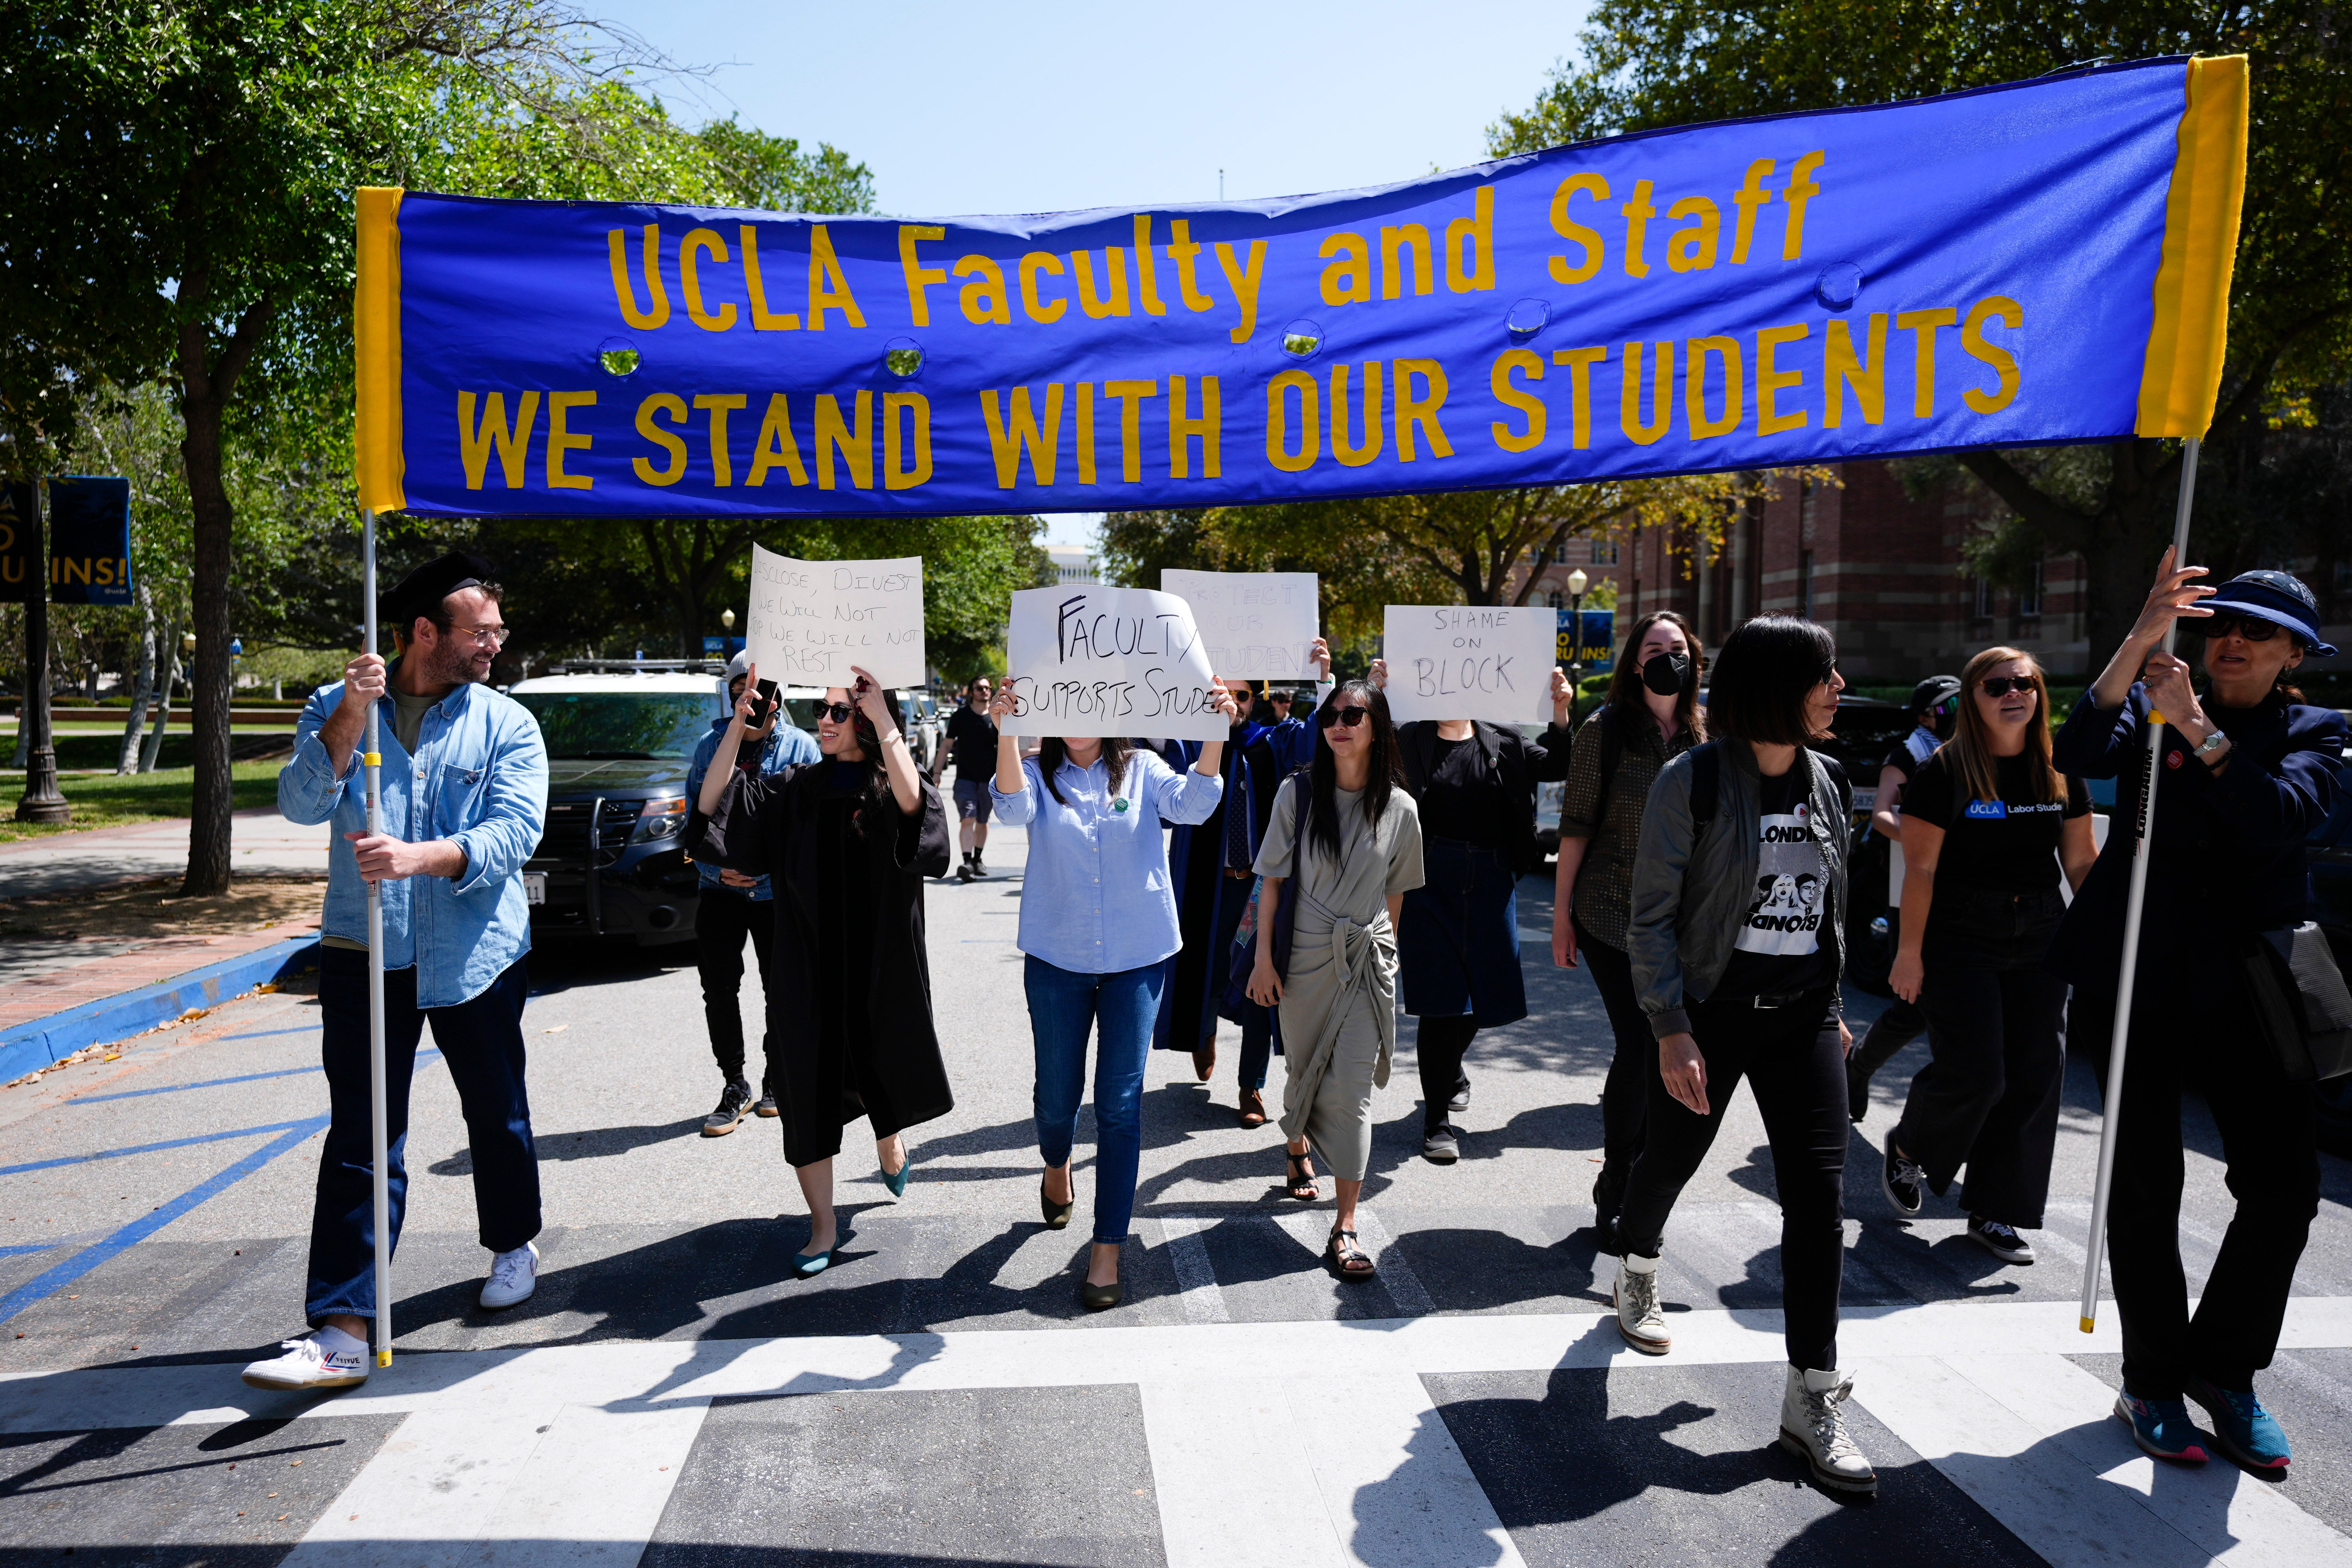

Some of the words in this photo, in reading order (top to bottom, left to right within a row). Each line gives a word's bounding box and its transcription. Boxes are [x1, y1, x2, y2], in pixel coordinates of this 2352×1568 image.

[608, 224, 866, 331] UCLA
[899, 215, 1267, 343] Faculty
[1319, 186, 1495, 306] and
[1548, 150, 1824, 284] Staff
[458, 390, 596, 490] WE
[633, 392, 932, 490] STAND
[980, 375, 1221, 488] WITH
[1267, 359, 1454, 471] OUR
[1492, 296, 2023, 452] STUDENTS
[51, 556, 127, 586] INS!
[755, 552, 817, 597] DISCLOSE,
[834, 568, 918, 592] DIVEST
[758, 590, 774, 613] WE
[780, 597, 821, 618] WILL
[835, 603, 887, 621] NOT
[1179, 576, 1297, 605] PROTECT
[749, 608, 763, 637] STOP
[770, 622, 794, 641] WE
[807, 630, 872, 646] WILL
[887, 629, 920, 645] NOT
[1059, 595, 1197, 664] FACULTY
[1206, 611, 1263, 633] OUR
[1435, 609, 1509, 630] SHAME
[1205, 641, 1320, 674] TUDENTS
[1453, 637, 1481, 648] ON
[1582, 647, 1612, 661] INS!
[782, 645, 841, 673] REST
[1415, 653, 1515, 697] BLOCK
[1010, 677, 1135, 722] SUPPORTS
[1970, 804, 2000, 814] UCLA
[2007, 805, 2034, 813] Labor
